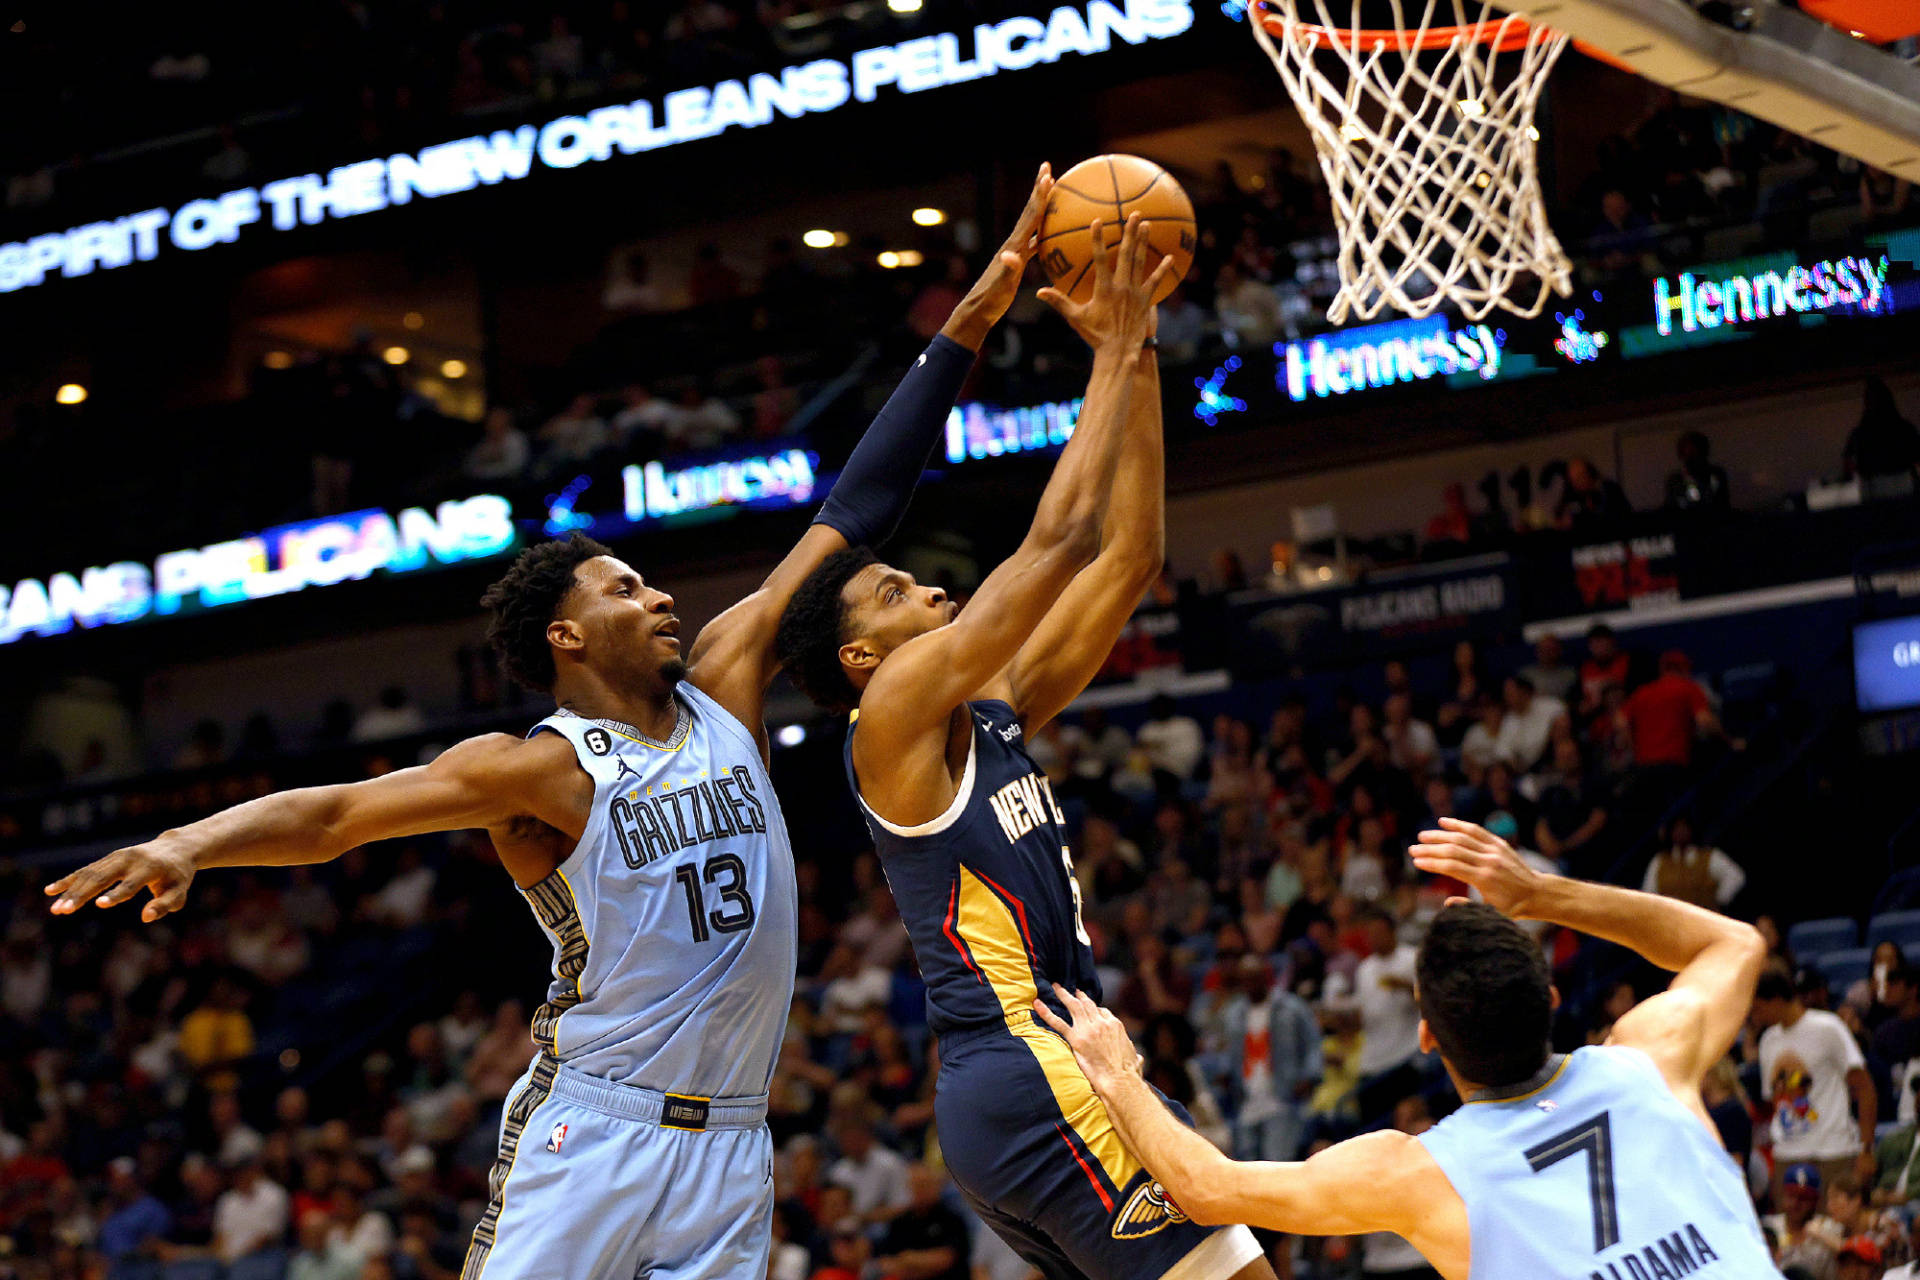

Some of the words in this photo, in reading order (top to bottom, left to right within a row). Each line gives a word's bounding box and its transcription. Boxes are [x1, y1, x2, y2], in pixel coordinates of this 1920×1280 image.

[0, 208, 169, 292] SPIRIT
[170, 187, 261, 250] OF
[262, 158, 386, 230] THE
[386, 125, 538, 206] NEW
[538, 60, 851, 168] ORLEANS
[852, 0, 1194, 102] PELICANS
[1653, 255, 1890, 336] Hennessy
[1286, 325, 1503, 402] Hennessy
[153, 494, 515, 615] PELICANS
[587, 731, 607, 754] 6
[610, 766, 766, 870] GRIZZLIES
[989, 773, 1048, 844] NEW
[675, 853, 755, 944] 13
[1523, 1110, 1620, 1254] 7
